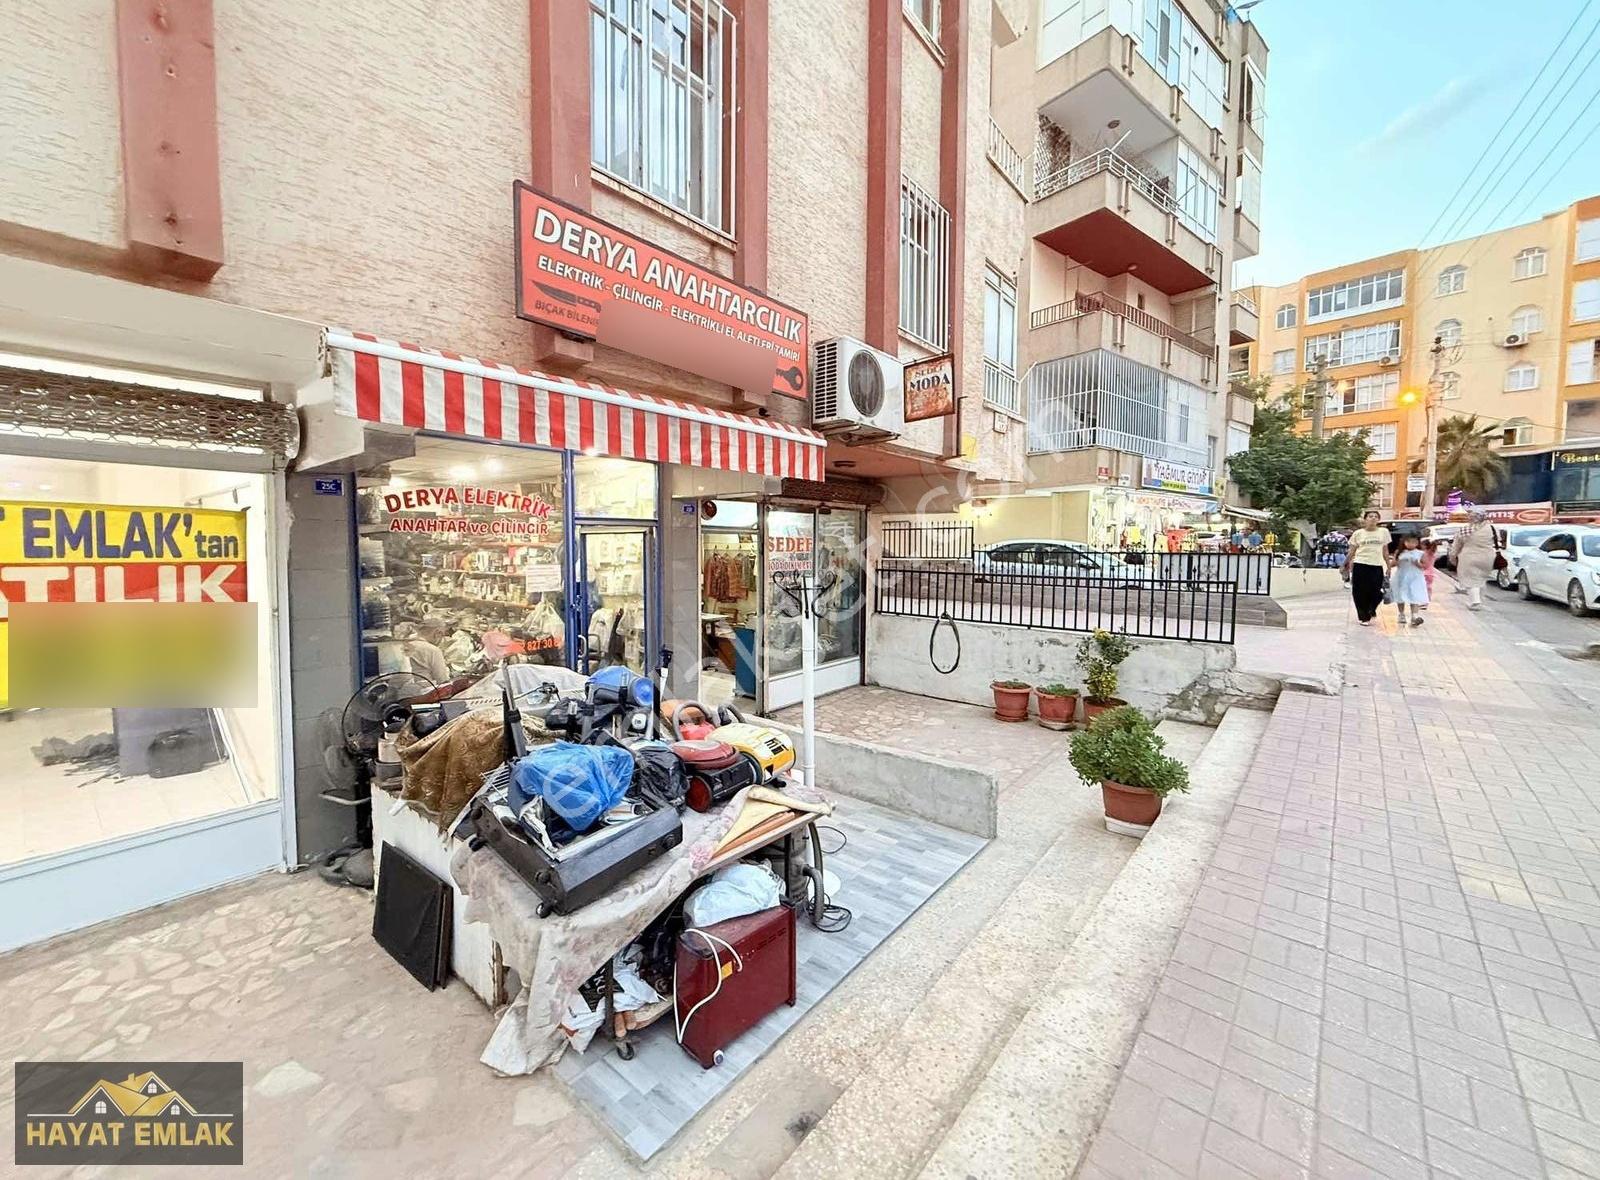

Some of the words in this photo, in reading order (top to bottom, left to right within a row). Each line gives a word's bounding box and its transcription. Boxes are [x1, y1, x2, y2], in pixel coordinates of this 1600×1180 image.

[532, 207, 639, 278] DERYA
[642, 257, 803, 344] ANAHTARCILIK
[538, 255, 604, 291] ELEKTRİK
[612, 282, 664, 312] ÇİLİNGİR
[725, 327, 736, 339] EL
[910, 373, 951, 392] MODA
[384, 487, 459, 513] DERYA
[463, 487, 553, 520] ELEKTRİK
[390, 518, 468, 533] ANAHTAR
[470, 523, 488, 533] ve
[767, 536, 813, 552] SEDEF
